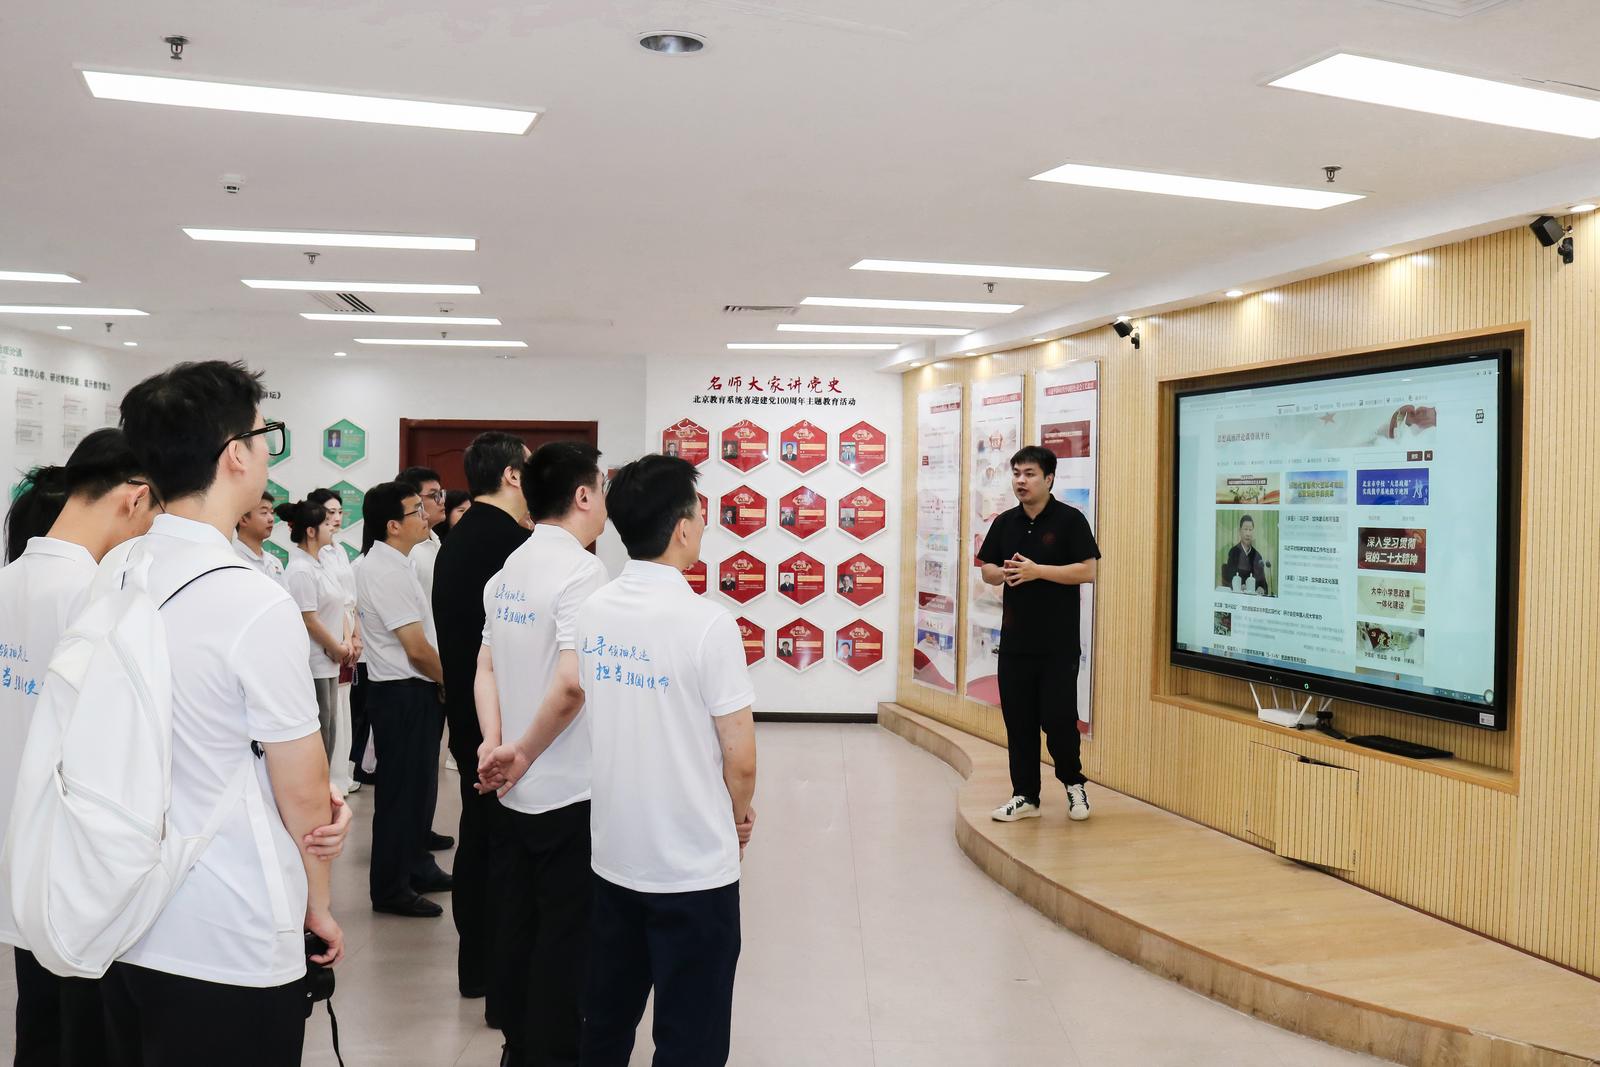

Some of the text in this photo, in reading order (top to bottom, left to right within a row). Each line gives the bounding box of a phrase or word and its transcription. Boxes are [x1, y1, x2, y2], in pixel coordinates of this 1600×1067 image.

[707, 375, 843, 394] 名师大家讲党史
[693, 394, 856, 406] 北京教育系统喜迎建党100周年主题教育活动
[1366, 536, 1417, 550] 深入学习贯彻
[1364, 551, 1418, 566] 党的二十大精神
[1371, 587, 1410, 598] 大中小学思政课
[1376, 600, 1405, 610] 一体化建设
[595, 662, 669, 694] 担当强国使命
